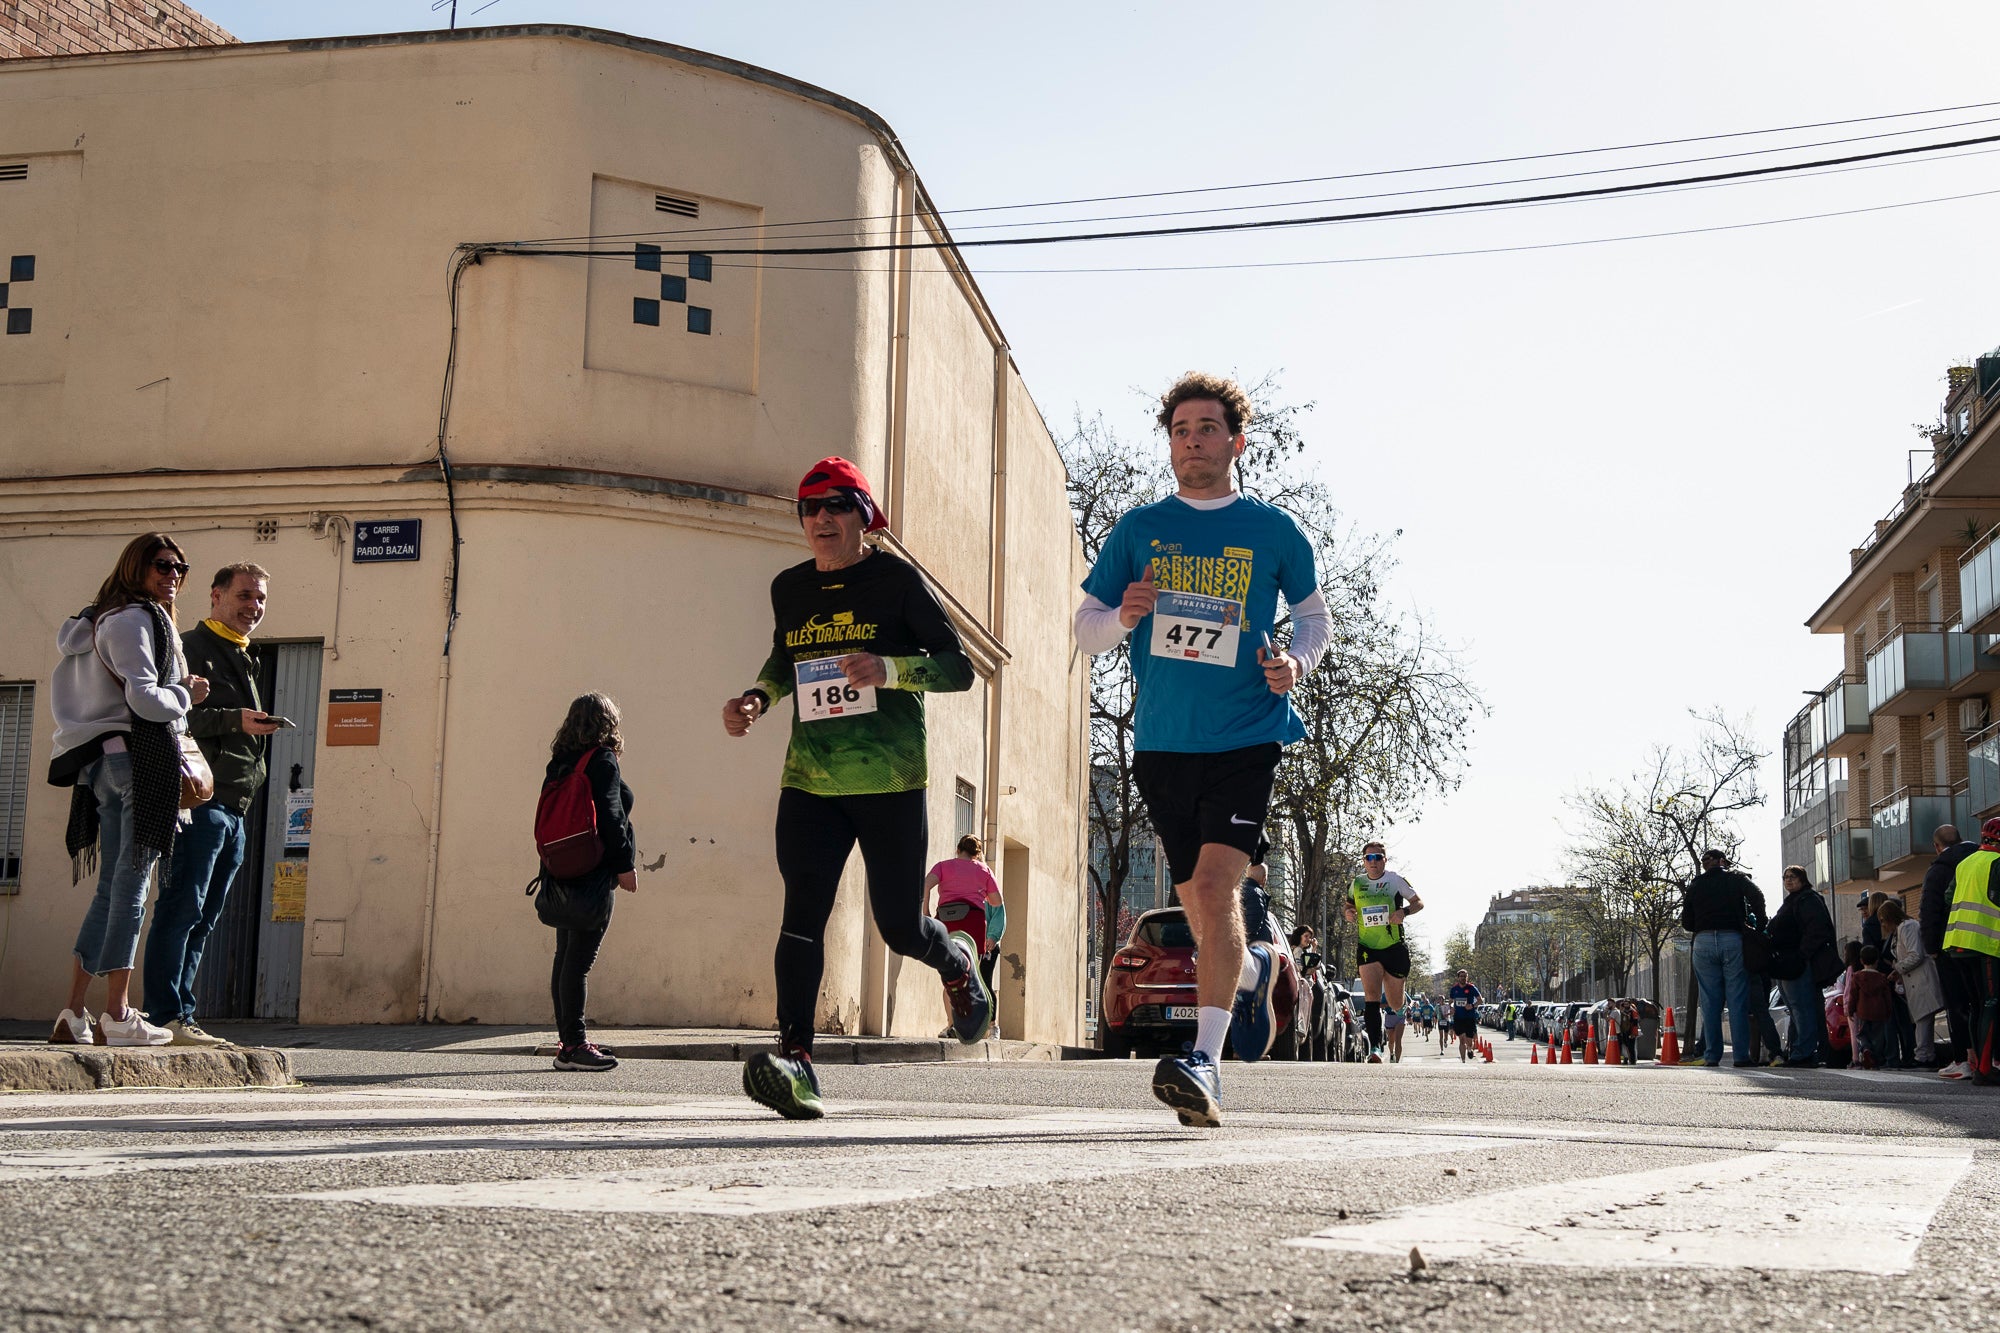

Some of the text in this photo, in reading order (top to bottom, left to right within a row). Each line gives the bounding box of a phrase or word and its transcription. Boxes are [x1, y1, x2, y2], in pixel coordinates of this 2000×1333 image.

[373, 526, 399, 534] CARRER
[357, 543, 414, 556] PARDO BAZÁN
[1155, 543, 1182, 552] avan
[1151, 555, 1252, 574] PARKINSON
[1172, 598, 1225, 612] PARKINSON
[816, 626, 845, 643] DRAC
[845, 624, 878, 640] RACE
[1166, 624, 1223, 650] 477
[812, 684, 860, 706] 186
[1367, 914, 1383, 922] 961
[1174, 1008, 1199, 1018] 4026
